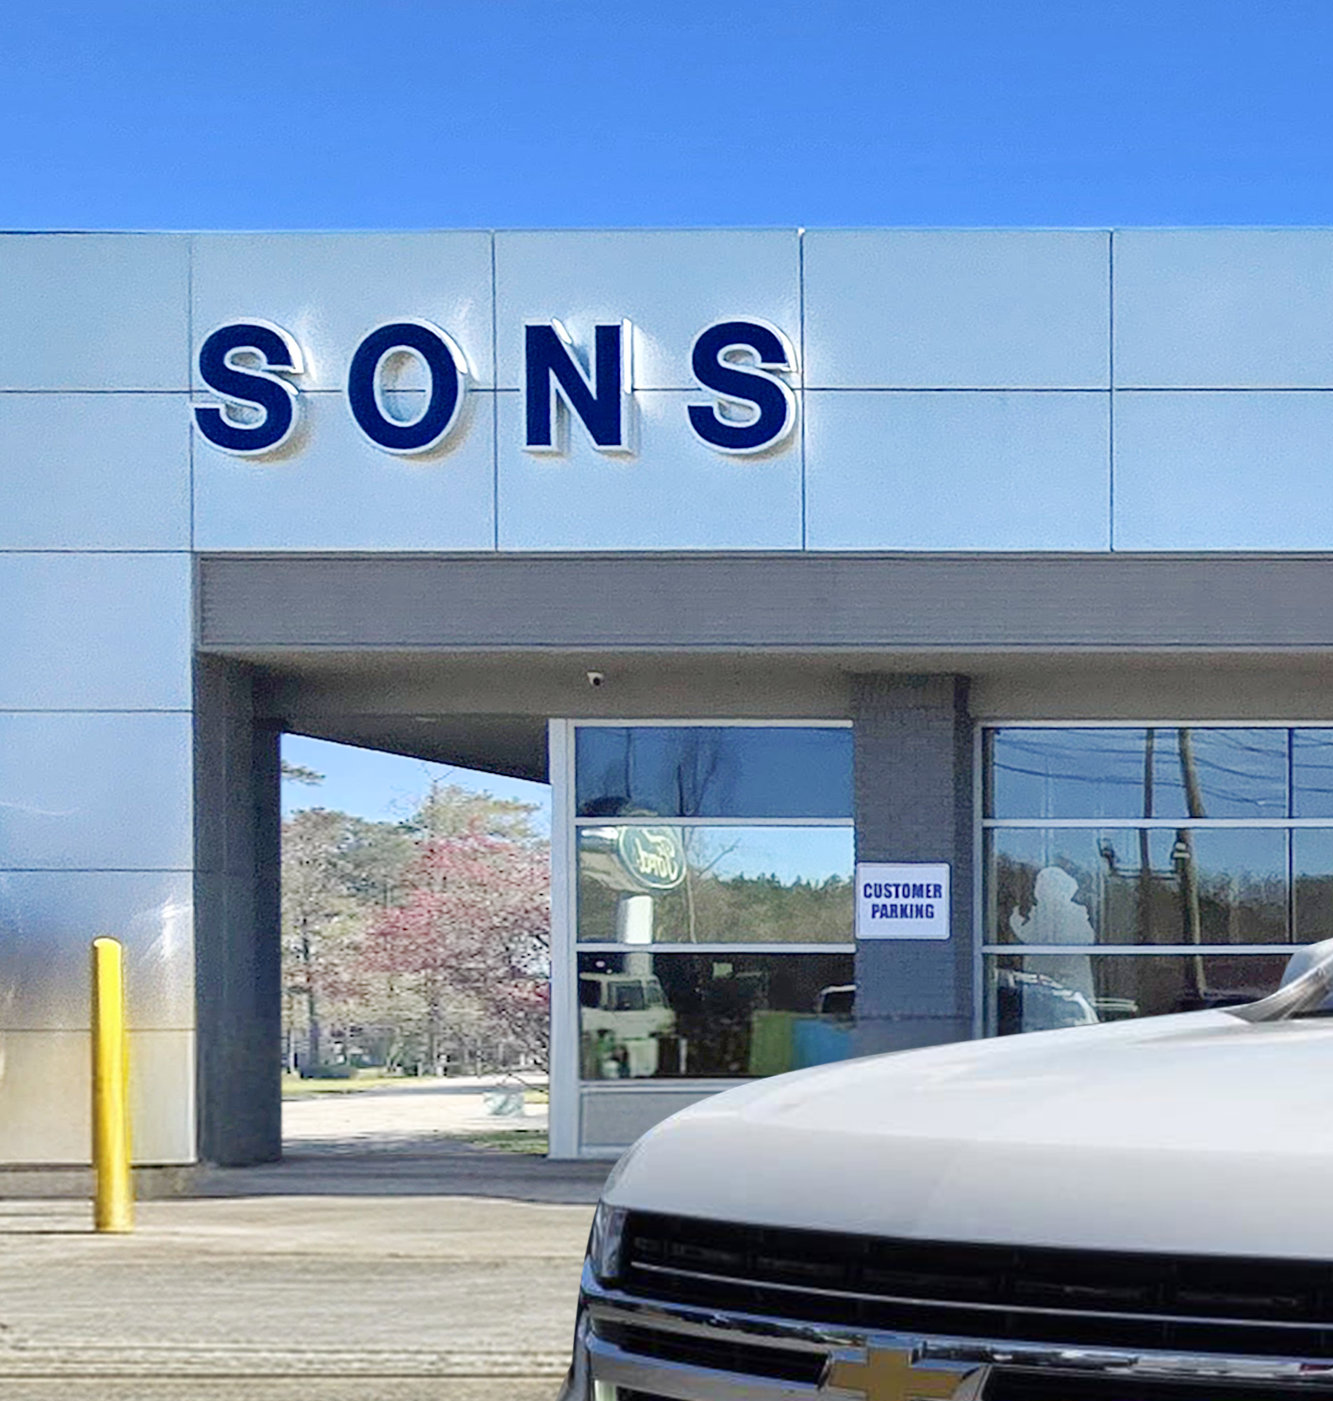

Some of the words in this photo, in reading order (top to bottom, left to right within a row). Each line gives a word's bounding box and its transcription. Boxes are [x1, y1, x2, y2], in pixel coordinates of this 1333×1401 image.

[194, 320, 798, 455] SONS
[863, 882, 942, 899] CUSTOMER
[871, 903, 934, 919] PARKING
